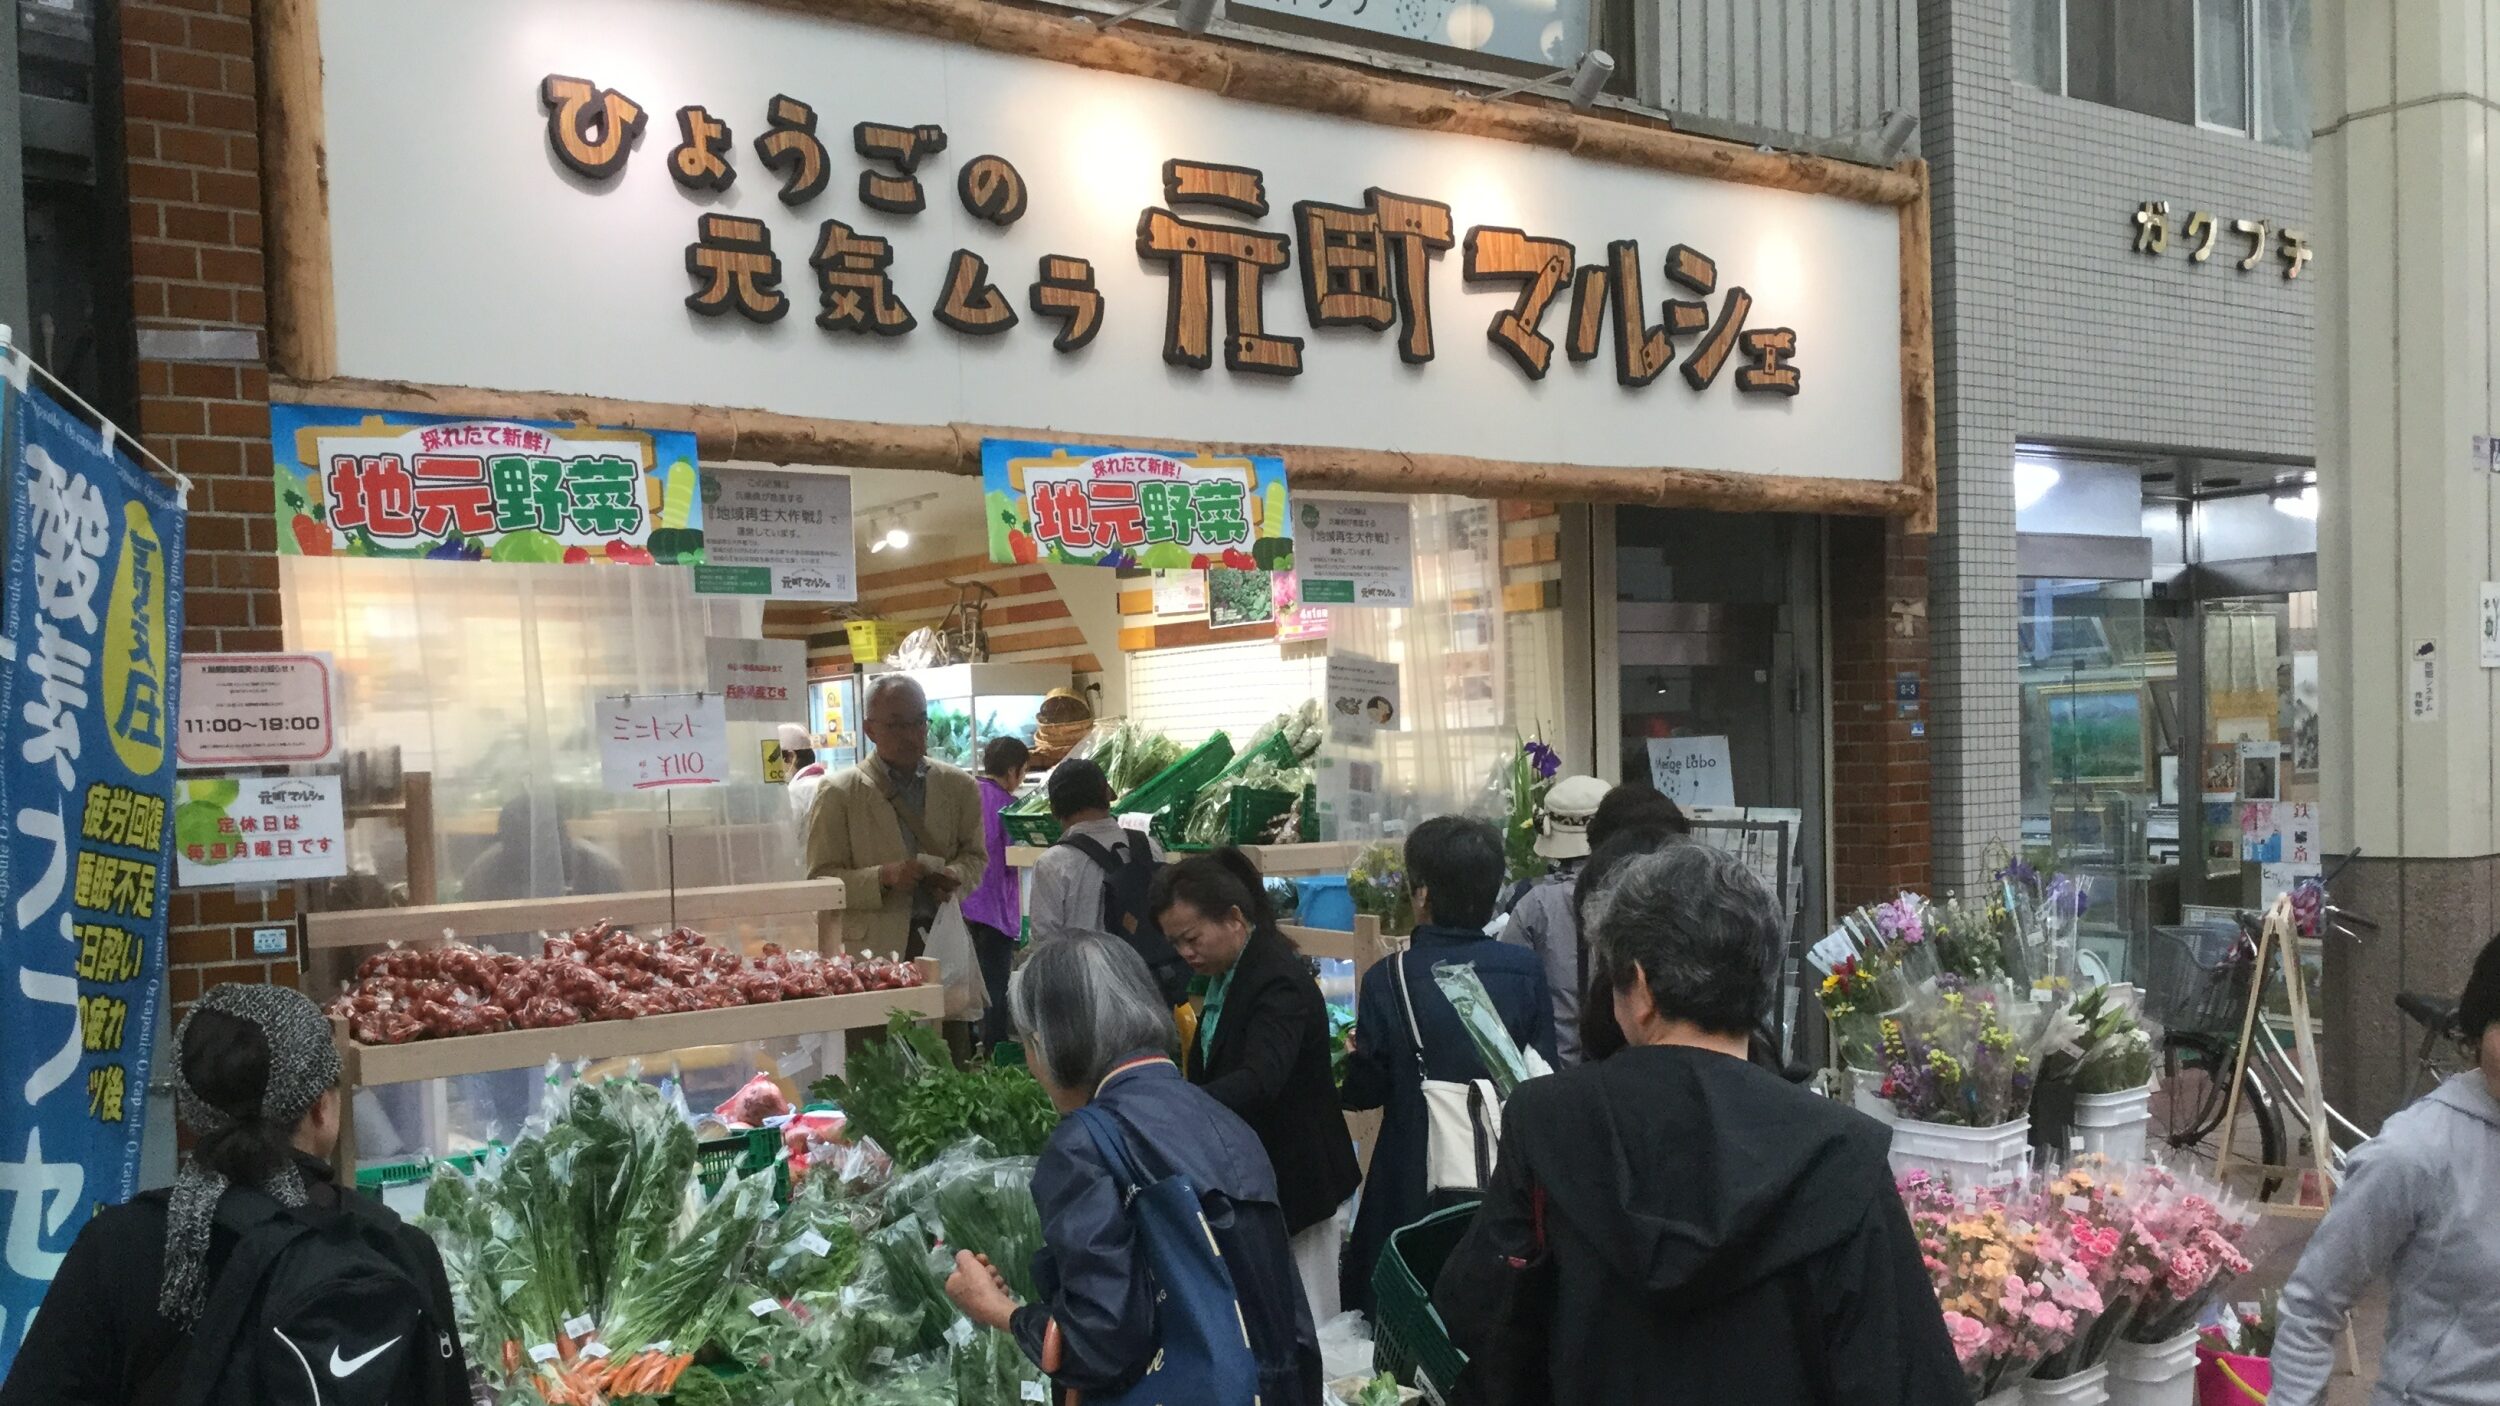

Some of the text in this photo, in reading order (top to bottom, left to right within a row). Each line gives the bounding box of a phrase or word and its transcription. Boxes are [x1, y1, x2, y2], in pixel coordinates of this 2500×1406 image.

[541, 73, 1028, 226] ひょうごの
[2132, 200, 2313, 280] ガクブチ
[685, 212, 1104, 352] 元気ムラ
[1136, 157, 1800, 396] 元町マルシェ
[420, 424, 551, 454] 採れたて新鮮!
[1092, 456, 1182, 479] 採れたて新鮮!
[328, 452, 642, 538] 地元野菜
[1032, 479, 1249, 549] 地元野菜
[614, 713, 702, 741] ミニトマト
[770, 770, 785, 780] CC
[258, 790, 325, 805] 元町マルシェ
[217, 815, 300, 833] 定休日は
[187, 837, 332, 860] 毎週月曜日です
